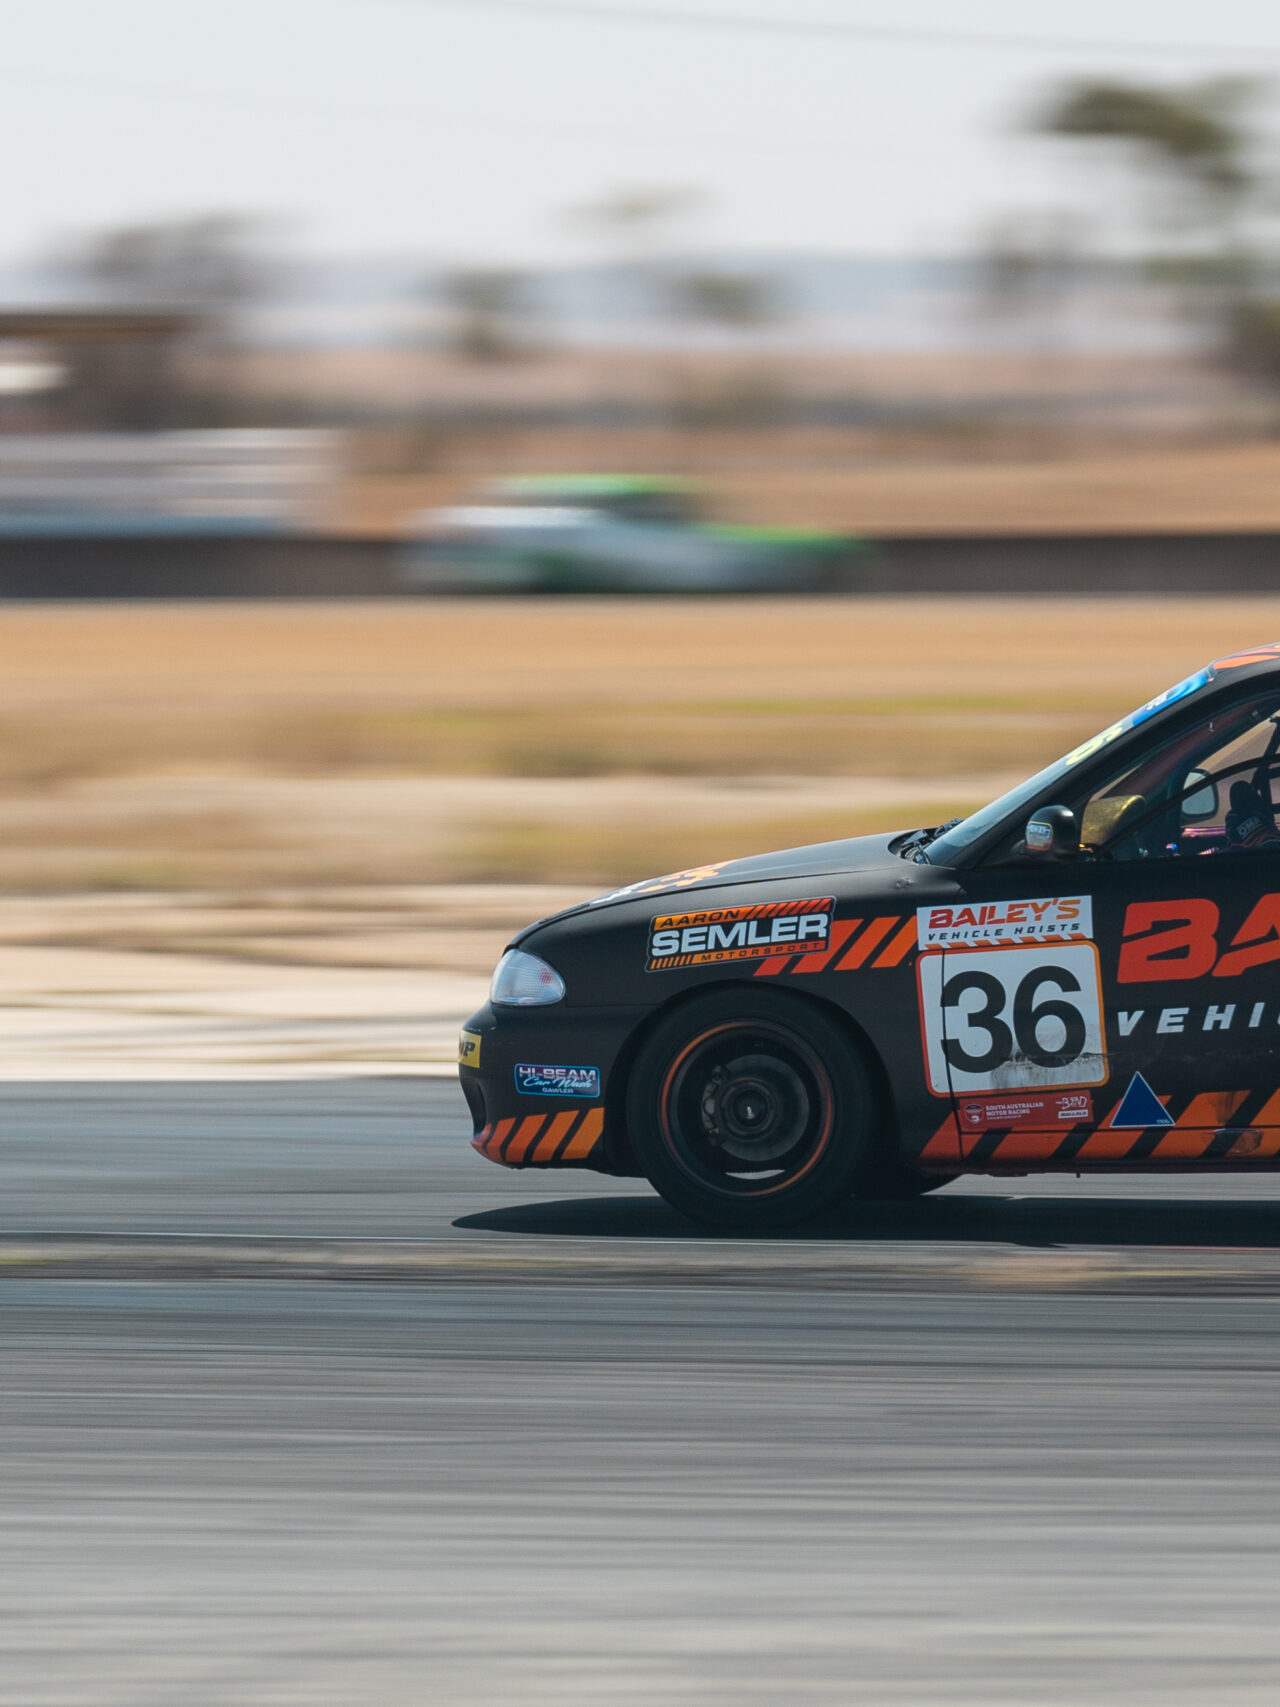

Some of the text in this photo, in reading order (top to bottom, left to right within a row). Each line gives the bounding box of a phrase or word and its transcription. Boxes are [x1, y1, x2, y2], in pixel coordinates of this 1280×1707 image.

[659, 909, 740, 928] AARON
[928, 898, 1081, 929] BAILEY'S
[651, 913, 828, 957] SEMLER
[928, 923, 1080, 941] VEHICLE HOISTS
[701, 942, 820, 961] MOTORSPORT
[940, 965, 1086, 1073] 36
[519, 1066, 596, 1080] HI-BEAM
[523, 1076, 593, 1088] Car Wash
[985, 1104, 1006, 1112] SOUTH
